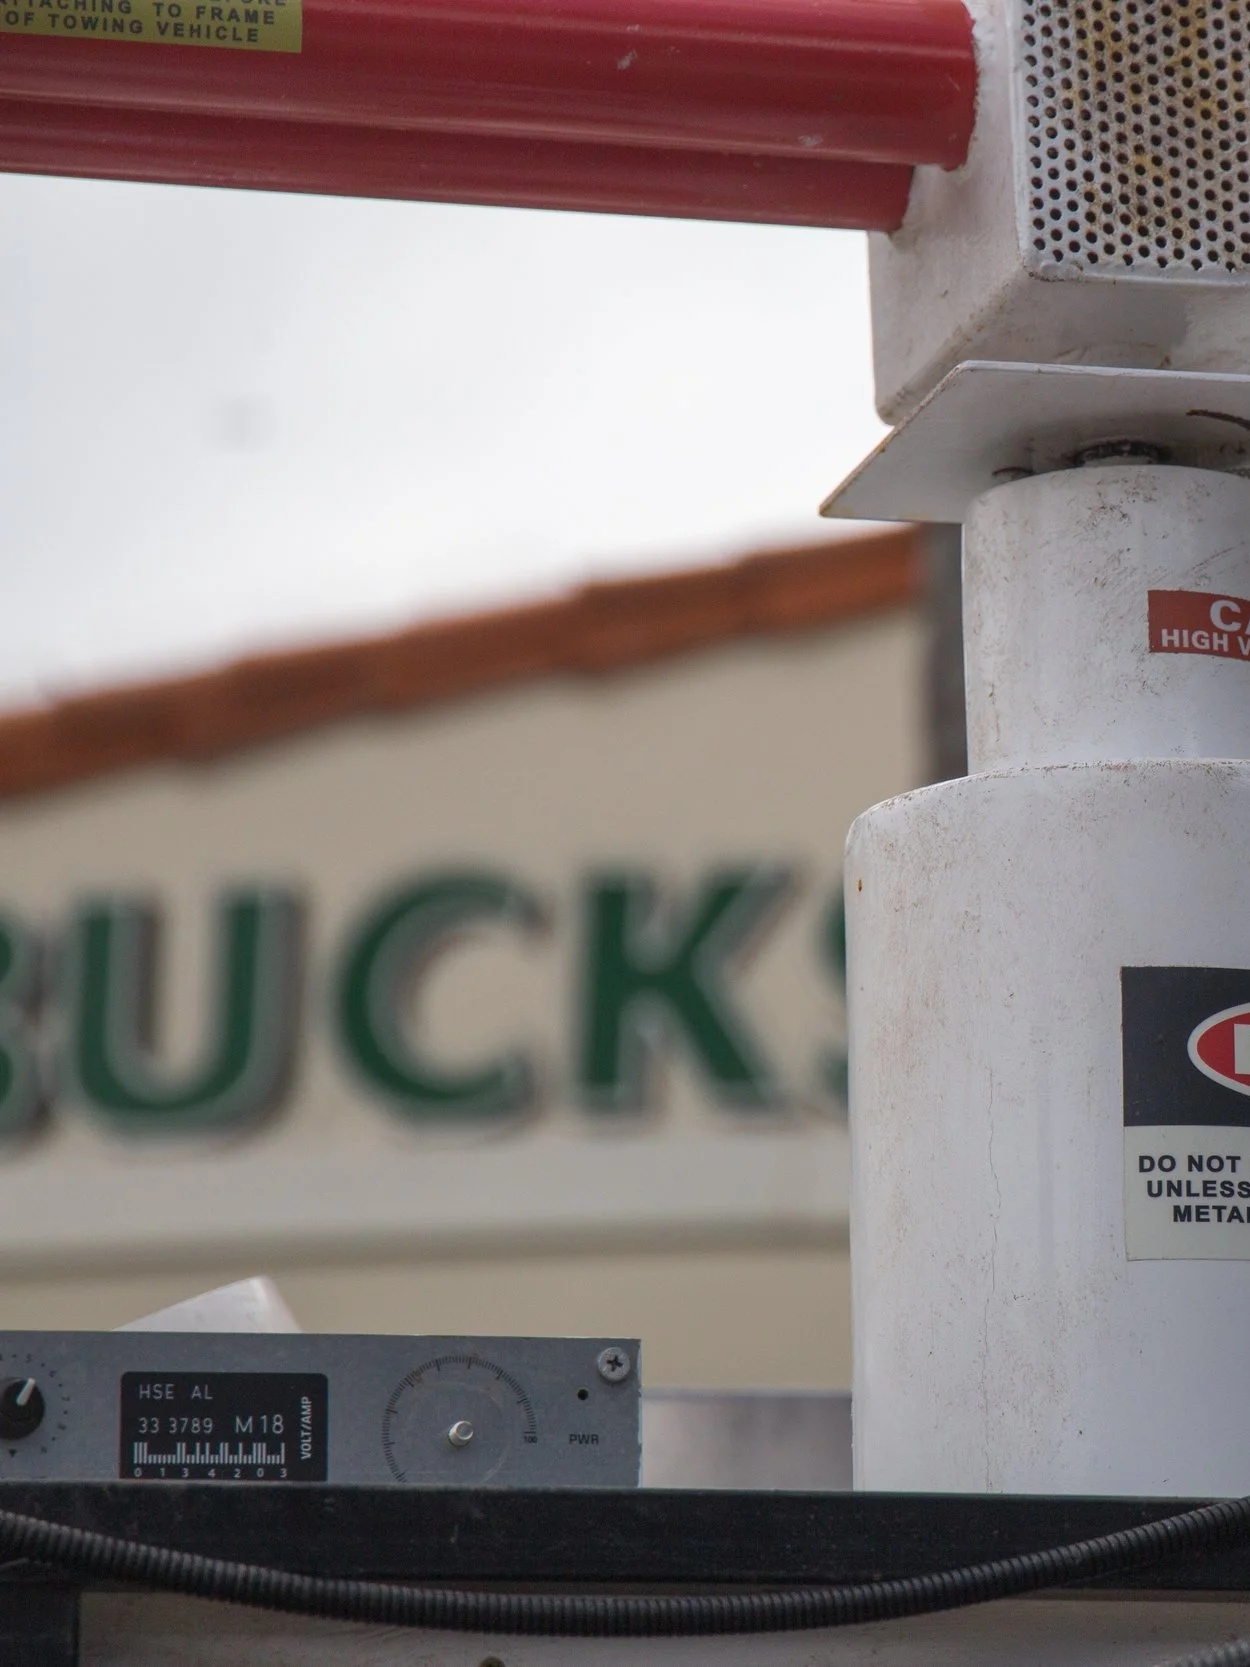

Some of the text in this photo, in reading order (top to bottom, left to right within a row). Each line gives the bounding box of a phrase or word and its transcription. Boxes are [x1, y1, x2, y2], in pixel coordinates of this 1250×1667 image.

[152, 2, 182, 17] TO
[196, 5, 275, 24] FRAME
[5, 11, 259, 42] OF TOWING VEHICLE
[1161, 629, 1229, 652] HIGH
[1138, 1155, 1176, 1173] DO
[1187, 1155, 1241, 1173] NOT
[139, 1384, 214, 1400] HSE AL
[139, 1417, 160, 1434] 33
[168, 1417, 213, 1434] 3789
[300, 1396, 312, 1460] VOLT/AMP
[569, 1434, 600, 1445] PWR
[134, 1467, 287, 1478] 0 1 3 4 2 0 3
